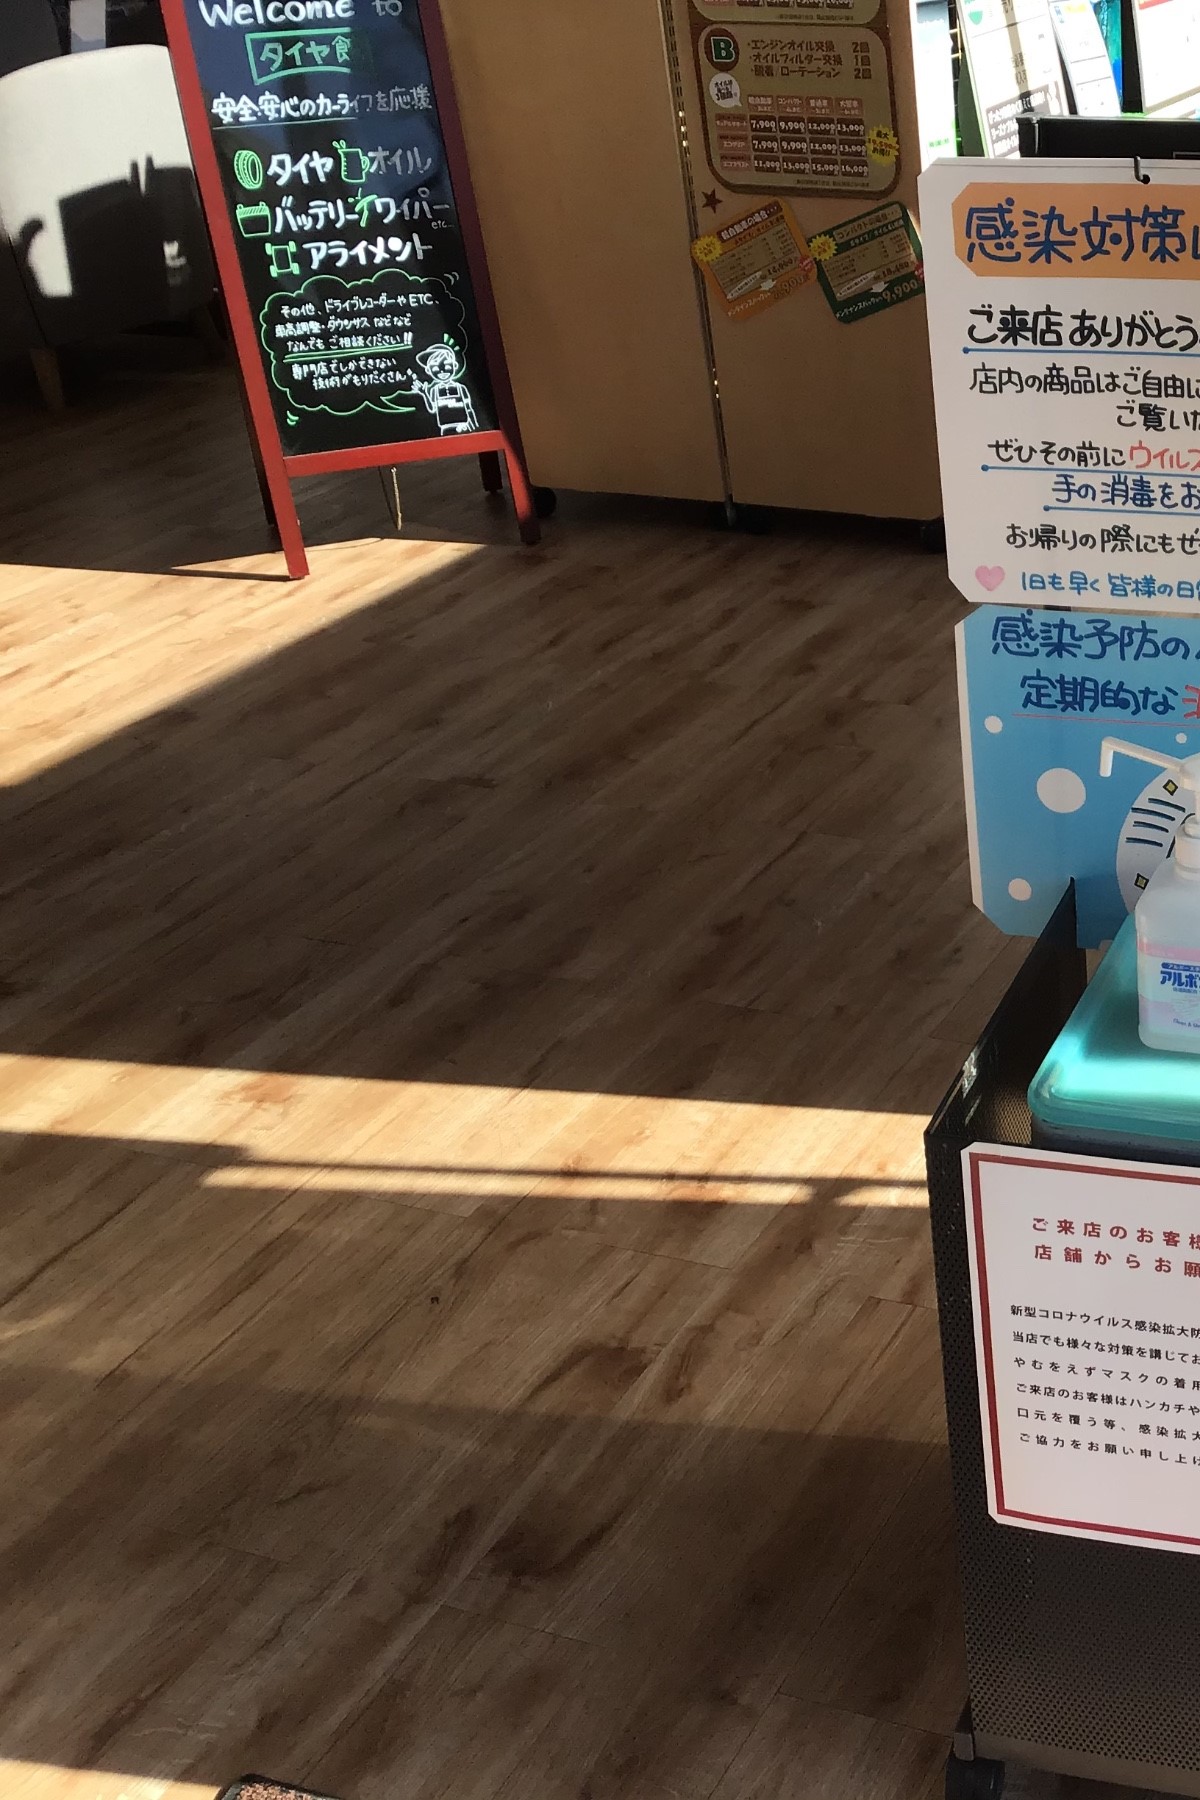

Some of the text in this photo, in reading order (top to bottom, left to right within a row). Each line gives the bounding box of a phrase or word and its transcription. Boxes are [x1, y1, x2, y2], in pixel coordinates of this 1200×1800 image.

[199, 0, 355, 27] Welcome
[710, 36, 735, 63] B
[267, 151, 334, 186] タイヤ
[368, 146, 432, 175] オイル
[274, 196, 359, 233] バッテリー
[374, 188, 450, 220] ワイパー
[302, 233, 433, 270] アライメント
